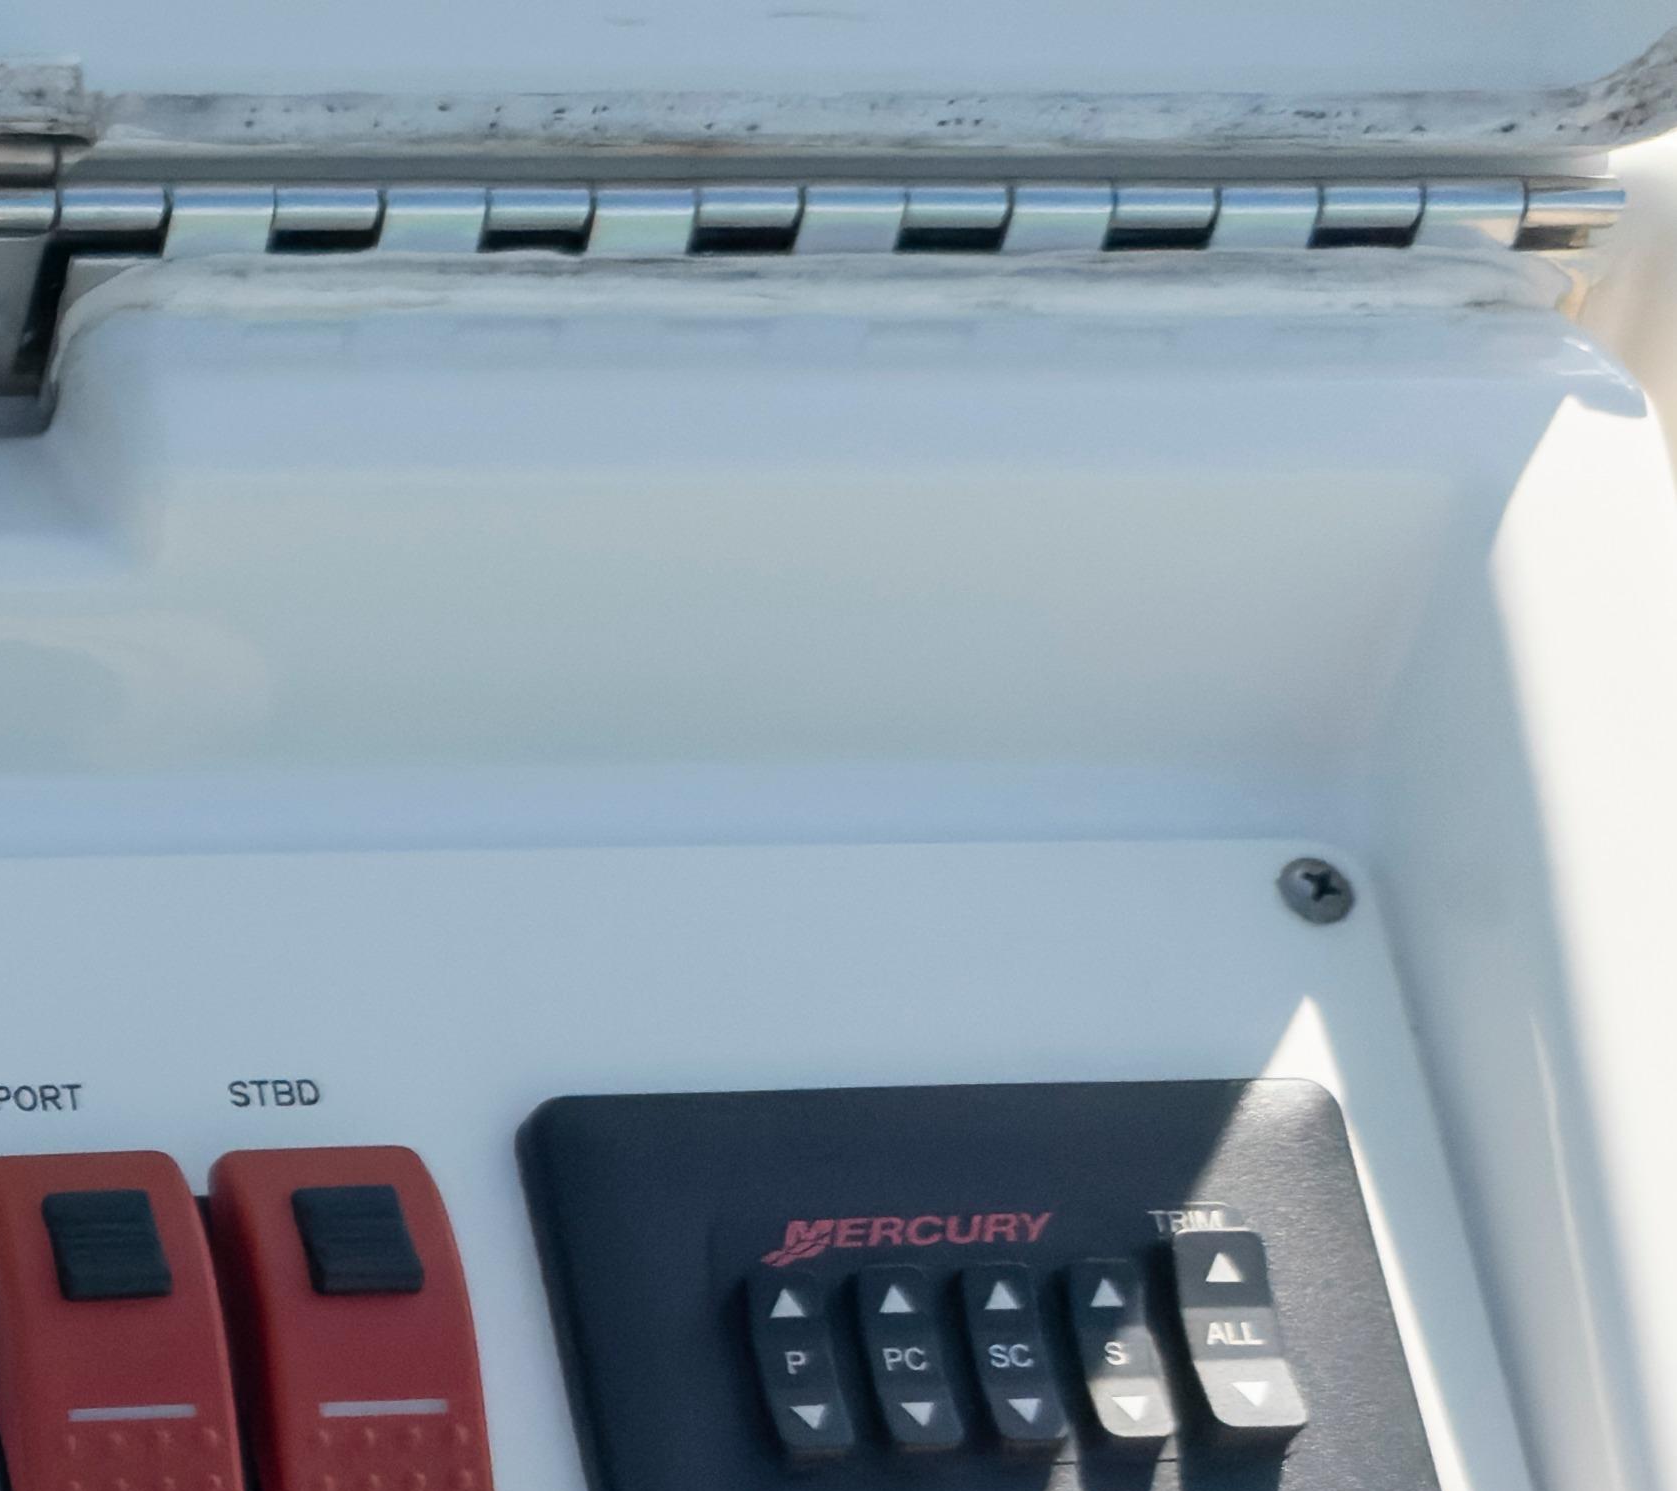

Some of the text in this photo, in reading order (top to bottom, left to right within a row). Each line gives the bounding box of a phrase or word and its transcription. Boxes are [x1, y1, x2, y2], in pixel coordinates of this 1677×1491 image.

[227, 1078, 322, 1109] STBD
[1146, 1209, 1224, 1234] TRIM
[760, 1211, 1054, 1268] MERCURY
[1206, 1321, 1265, 1346] ALL
[785, 1350, 807, 1375] P
[881, 1345, 929, 1372] PC
[988, 1342, 1035, 1369] SC
[1103, 1341, 1129, 1366] S
